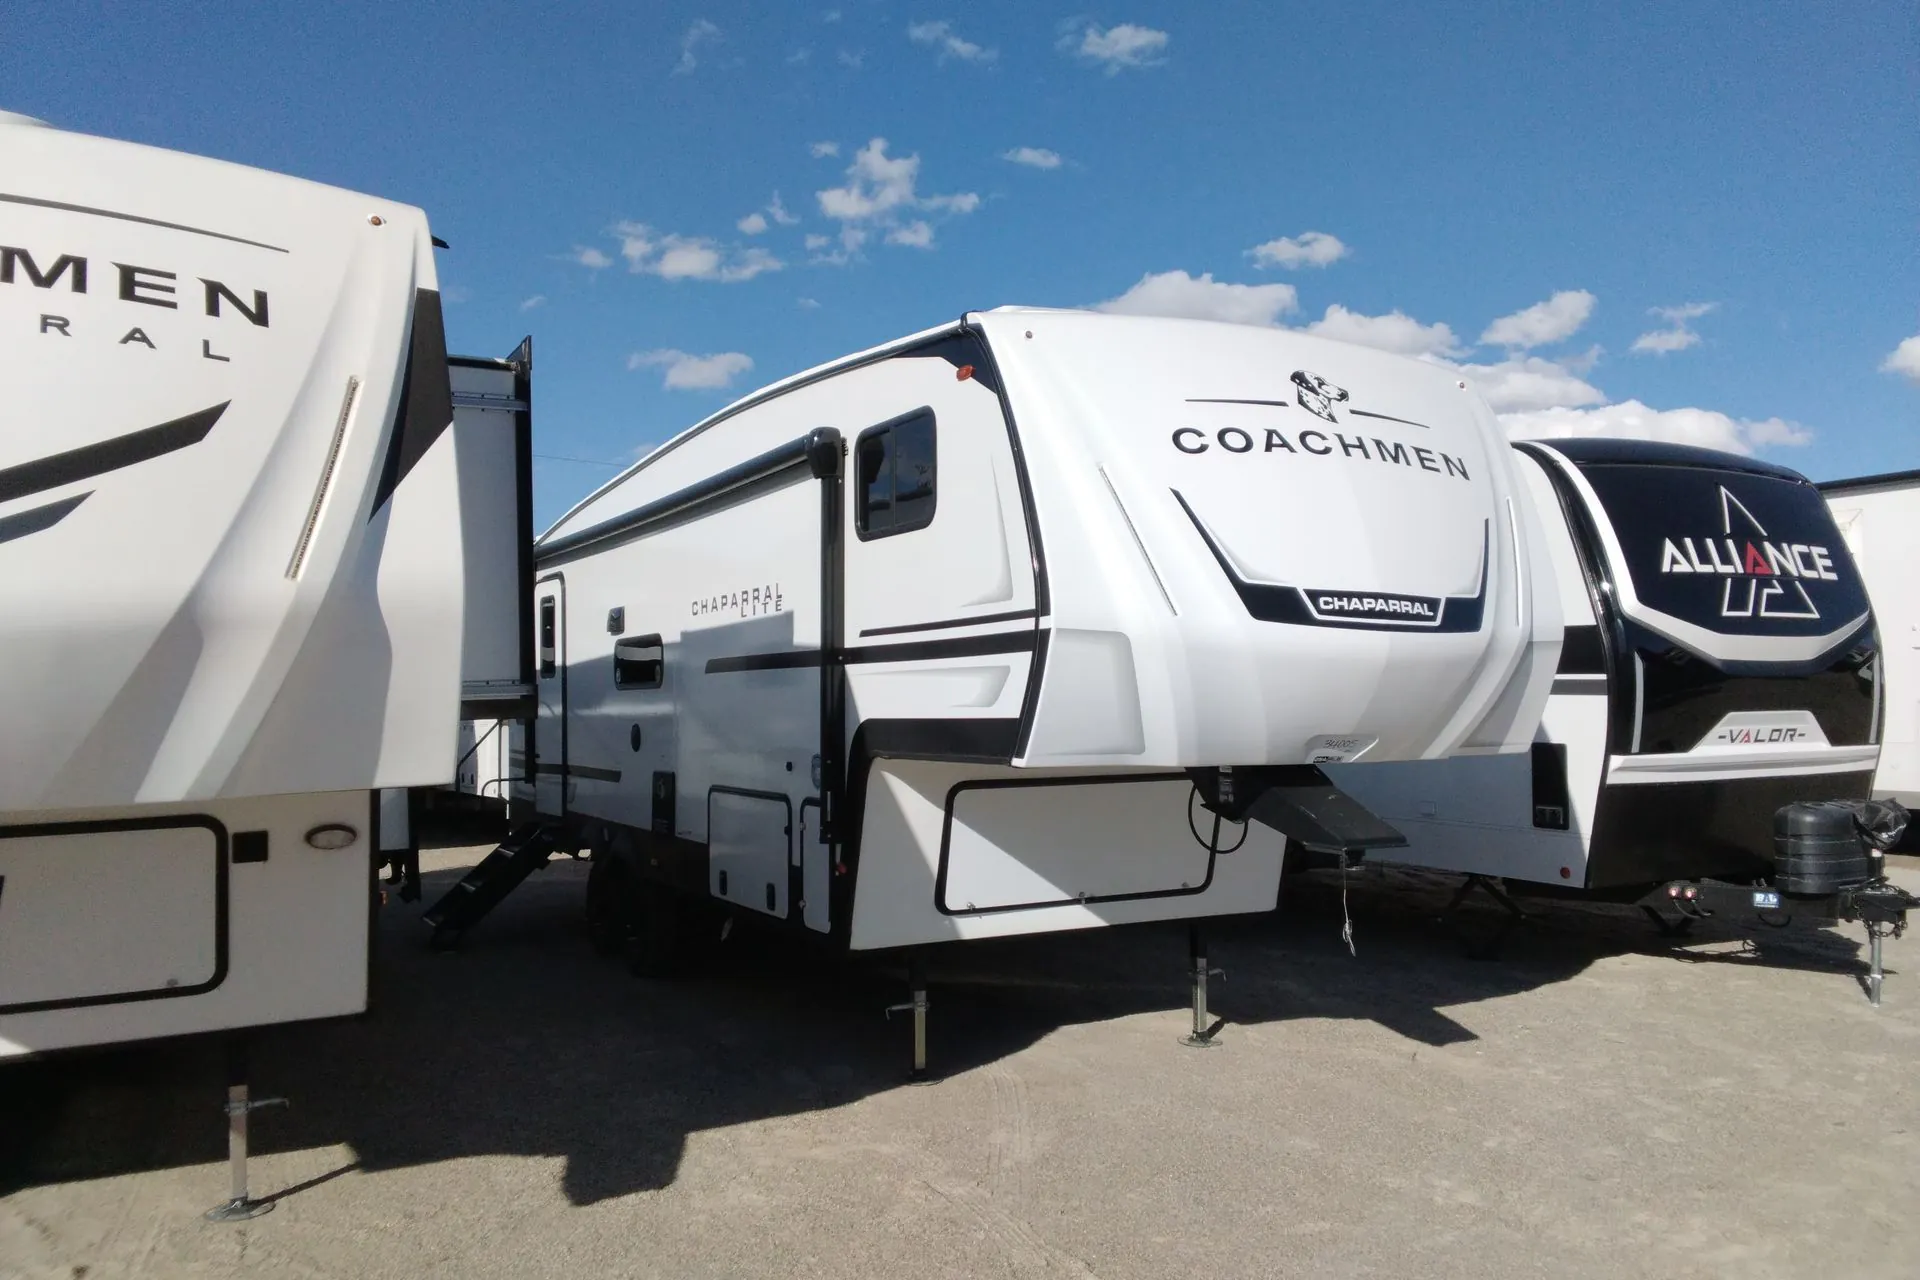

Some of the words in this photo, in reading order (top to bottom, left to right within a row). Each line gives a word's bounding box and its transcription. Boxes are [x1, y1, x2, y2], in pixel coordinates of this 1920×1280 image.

[1172, 427, 1471, 481] COACHMEN
[1662, 537, 1838, 580] ALLIANCE
[691, 583, 782, 616] CHAPARRAL
[740, 600, 782, 618] LITE
[1319, 596, 1434, 616] CHAPARRAL
